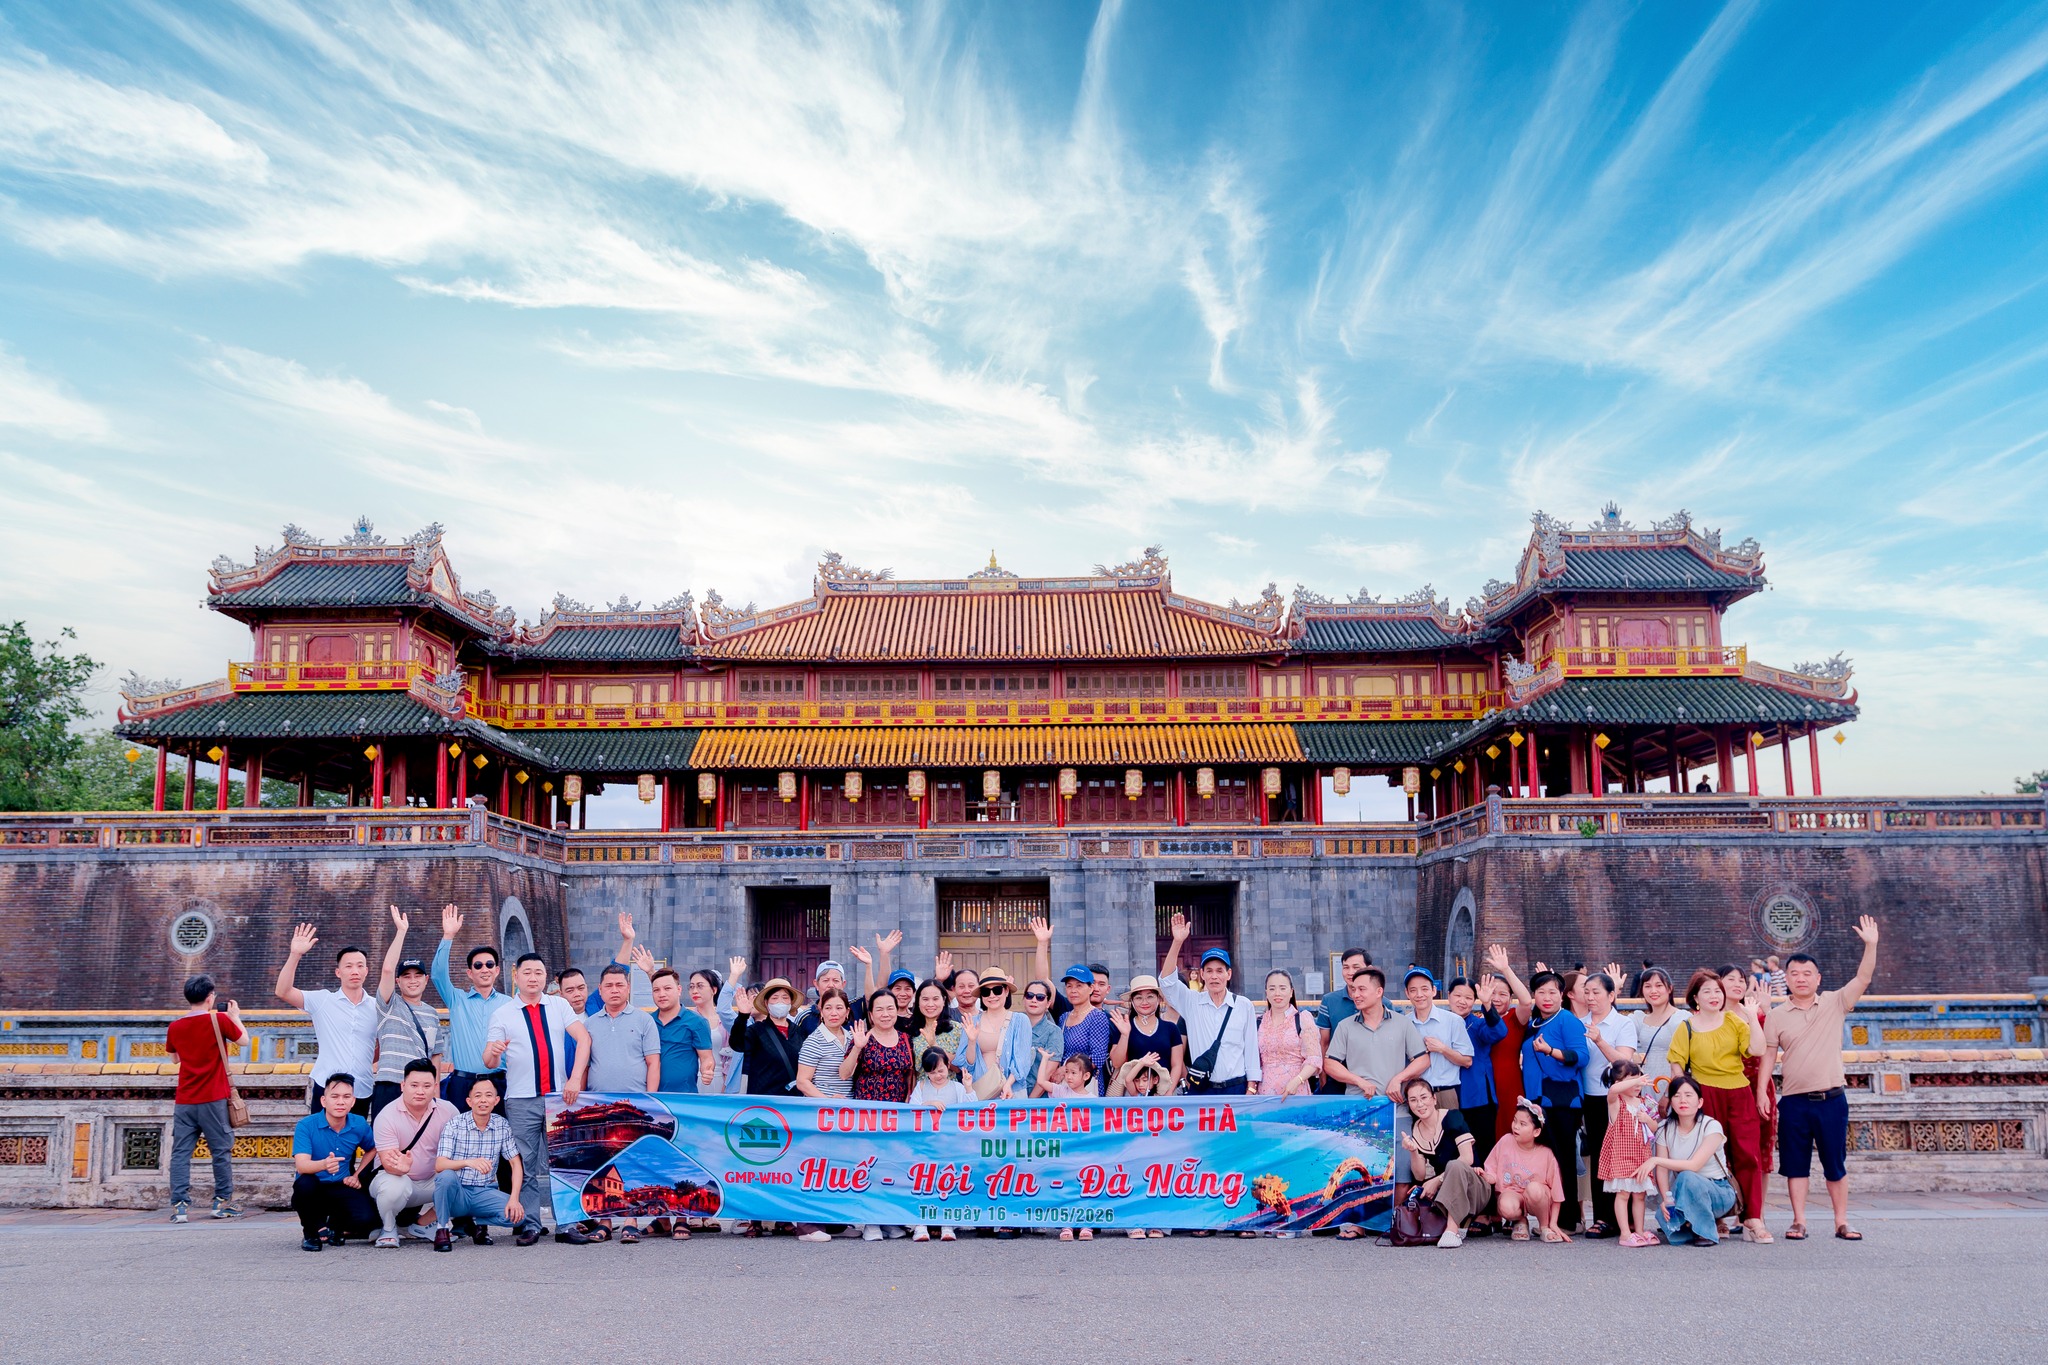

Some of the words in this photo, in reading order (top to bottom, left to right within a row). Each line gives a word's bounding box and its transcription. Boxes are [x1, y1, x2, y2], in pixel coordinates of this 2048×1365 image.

[911, 1109, 943, 1132] TY
[957, 1103, 997, 1132] CỔ
[1104, 1107, 1185, 1137] NGỌC
[1198, 1103, 1237, 1132] HÀ
[981, 1139, 1007, 1158] DU
[1015, 1139, 1061, 1162] LỊCH
[724, 1171, 793, 1184] GMP-WHO
[799, 1155, 876, 1190] Huế
[908, 1163, 974, 1198] Hội
[986, 1164, 1039, 1197] An
[1078, 1164, 1132, 1196] Đà
[1144, 1157, 1246, 1206] Nẵng
[919, 1205, 938, 1220] Từ
[943, 1205, 981, 1222] ngày
[988, 1206, 1006, 1221] 16
[1025, 1207, 1114, 1223] 19/05/2026
